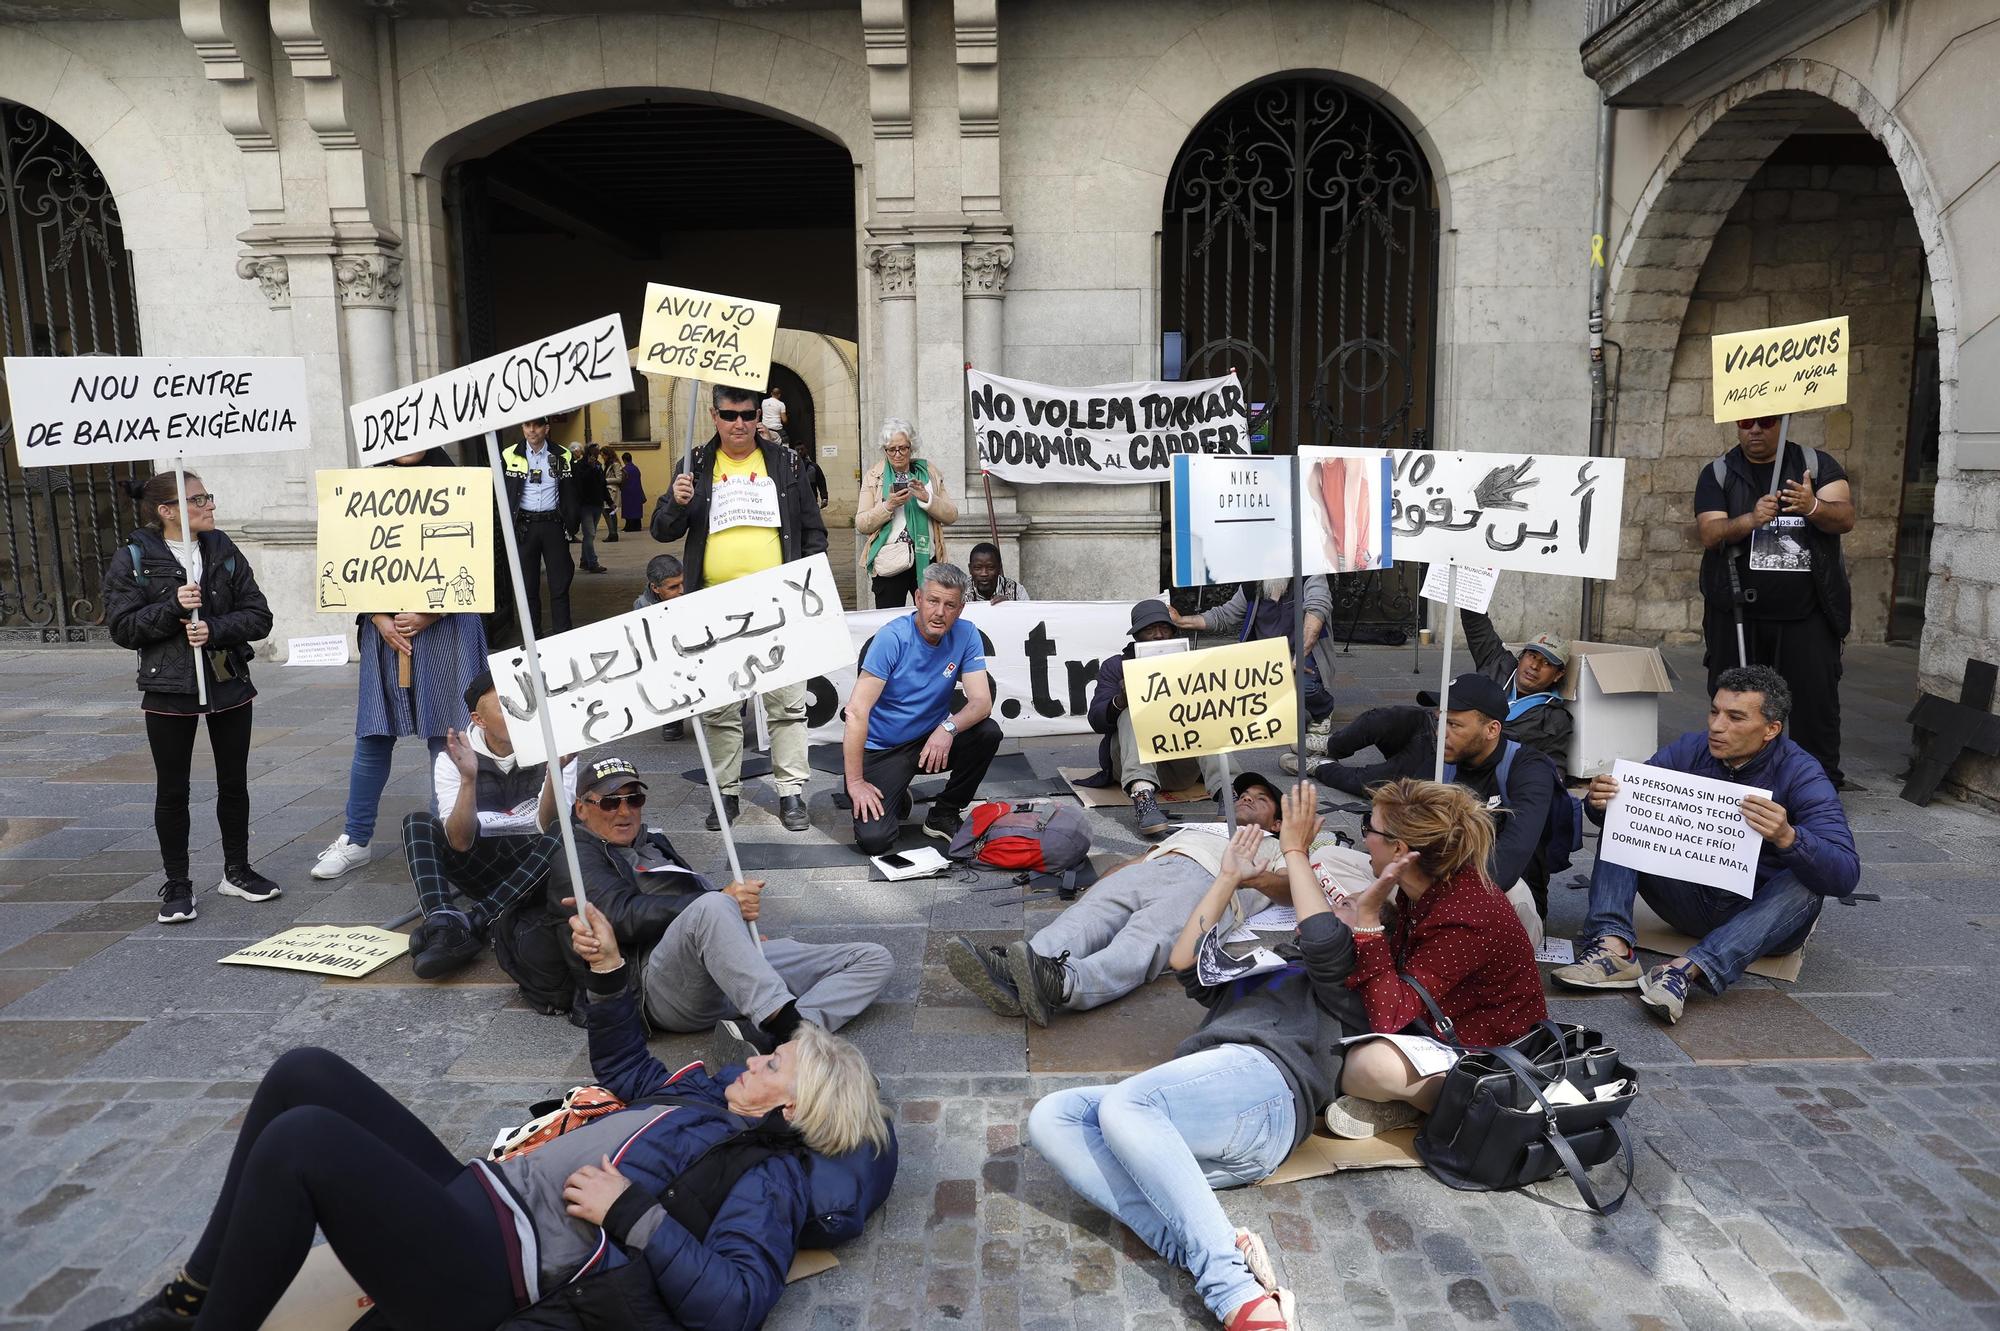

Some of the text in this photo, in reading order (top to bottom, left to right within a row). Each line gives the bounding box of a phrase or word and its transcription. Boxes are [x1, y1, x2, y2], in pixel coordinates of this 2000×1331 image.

[656, 296, 755, 326] AVUI JO
[678, 323, 740, 352] DEMÀ
[1725, 327, 1841, 374] VIACRUCIS
[647, 342, 760, 379] POTS SER...
[71, 370, 253, 403] NOU CENTRE
[362, 325, 616, 452] DRET A UN SOSTRE
[1723, 381, 1770, 406] MADE
[1793, 362, 1838, 383] NÚRIA
[971, 383, 1248, 434] NO VOLEM TORNAR
[26, 403, 298, 448] DE BAIXA EXIGÈNCIA
[1230, 471, 1259, 485] NIKE
[1219, 493, 1271, 508] OPTICAL
[370, 524, 405, 550] DE
[342, 555, 446, 586] GIRONA
[1140, 661, 1284, 703] JA VAN UNS
[1168, 691, 1268, 727] QUANTS
[1151, 730, 1202, 754] R.I.P.
[1622, 773, 1640, 785] LAS
[1641, 778, 1695, 798] PERSONAS
[1696, 790, 1715, 802] SIN
[1624, 804, 1746, 839] TODO EL AÑO, NO SOLO
[1632, 791, 1742, 822] NECESITAMOS TECHO
[1629, 821, 1736, 852] CUANDO HACE FRÍO!
[1611, 832, 1749, 873] DORMIR EN LA CALLE MATA
[346, 933, 391, 943] AND
[286, 952, 368, 971] HUMANS
